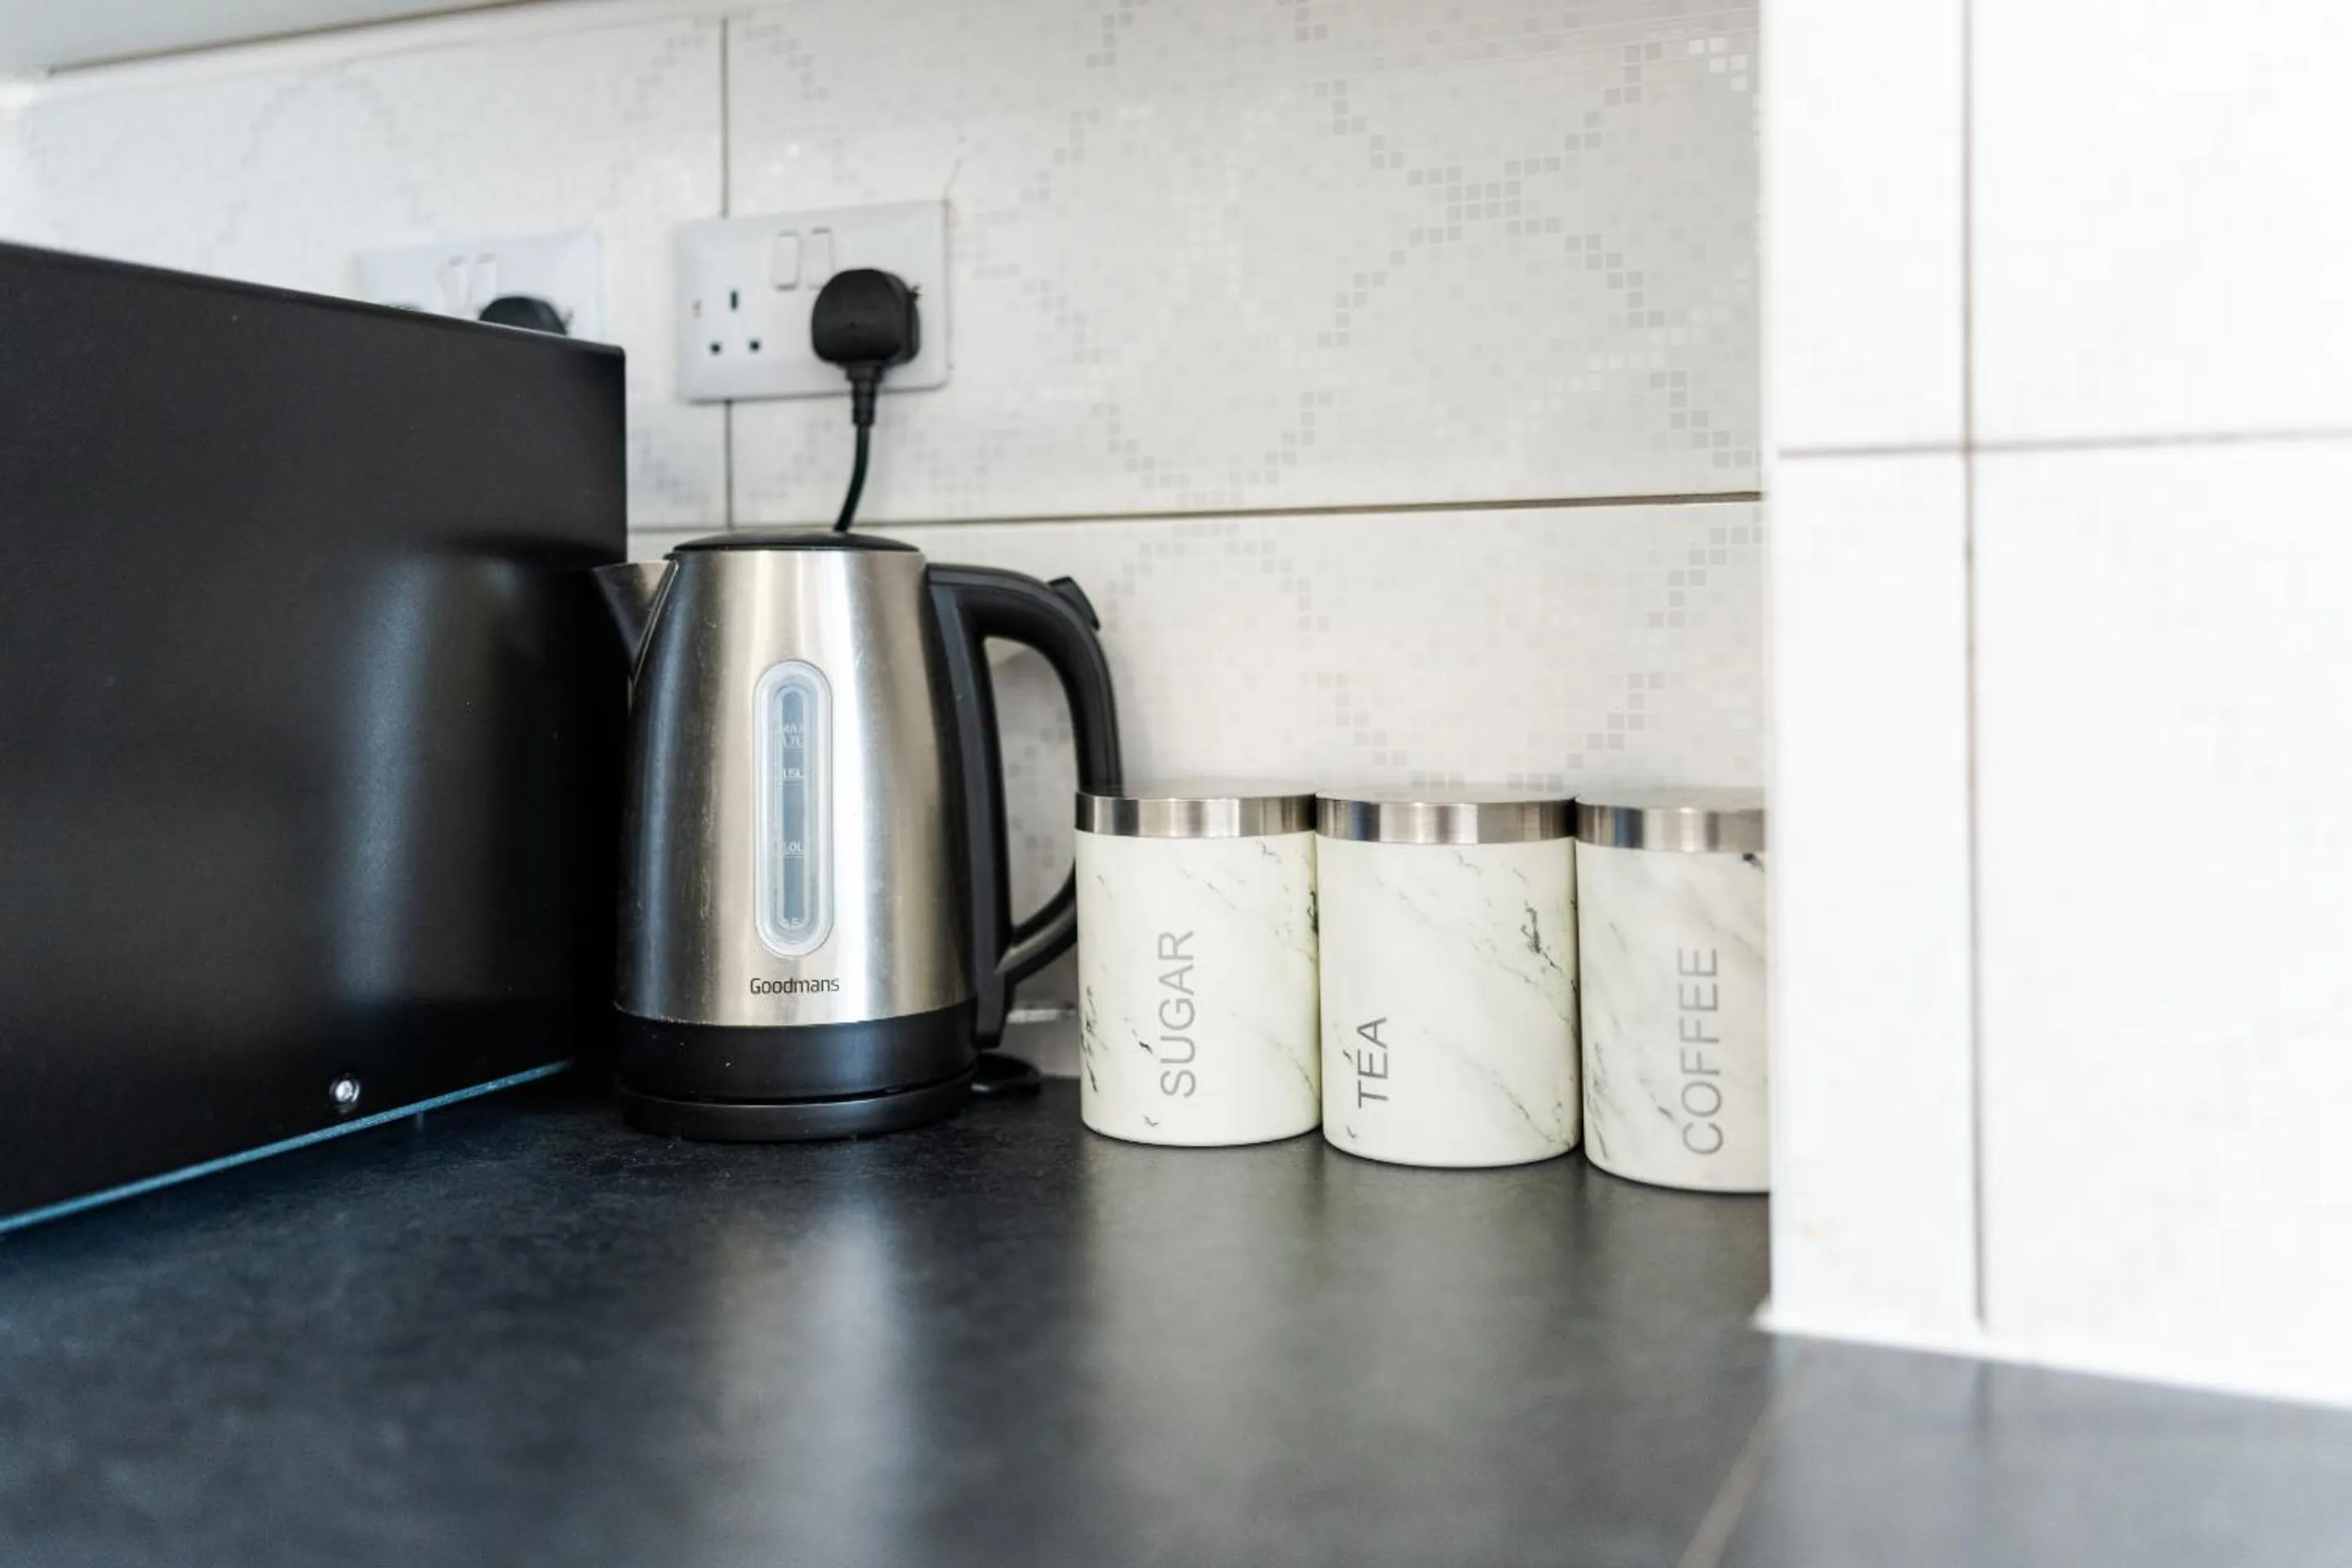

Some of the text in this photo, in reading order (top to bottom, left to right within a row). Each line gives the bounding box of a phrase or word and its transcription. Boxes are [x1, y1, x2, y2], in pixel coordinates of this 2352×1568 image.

[749, 977, 840, 994] Goodmans
[1158, 931, 1196, 1099] SUGAR
[1356, 1017, 1389, 1110] TEA
[1677, 947, 1724, 1156] COFFEE
